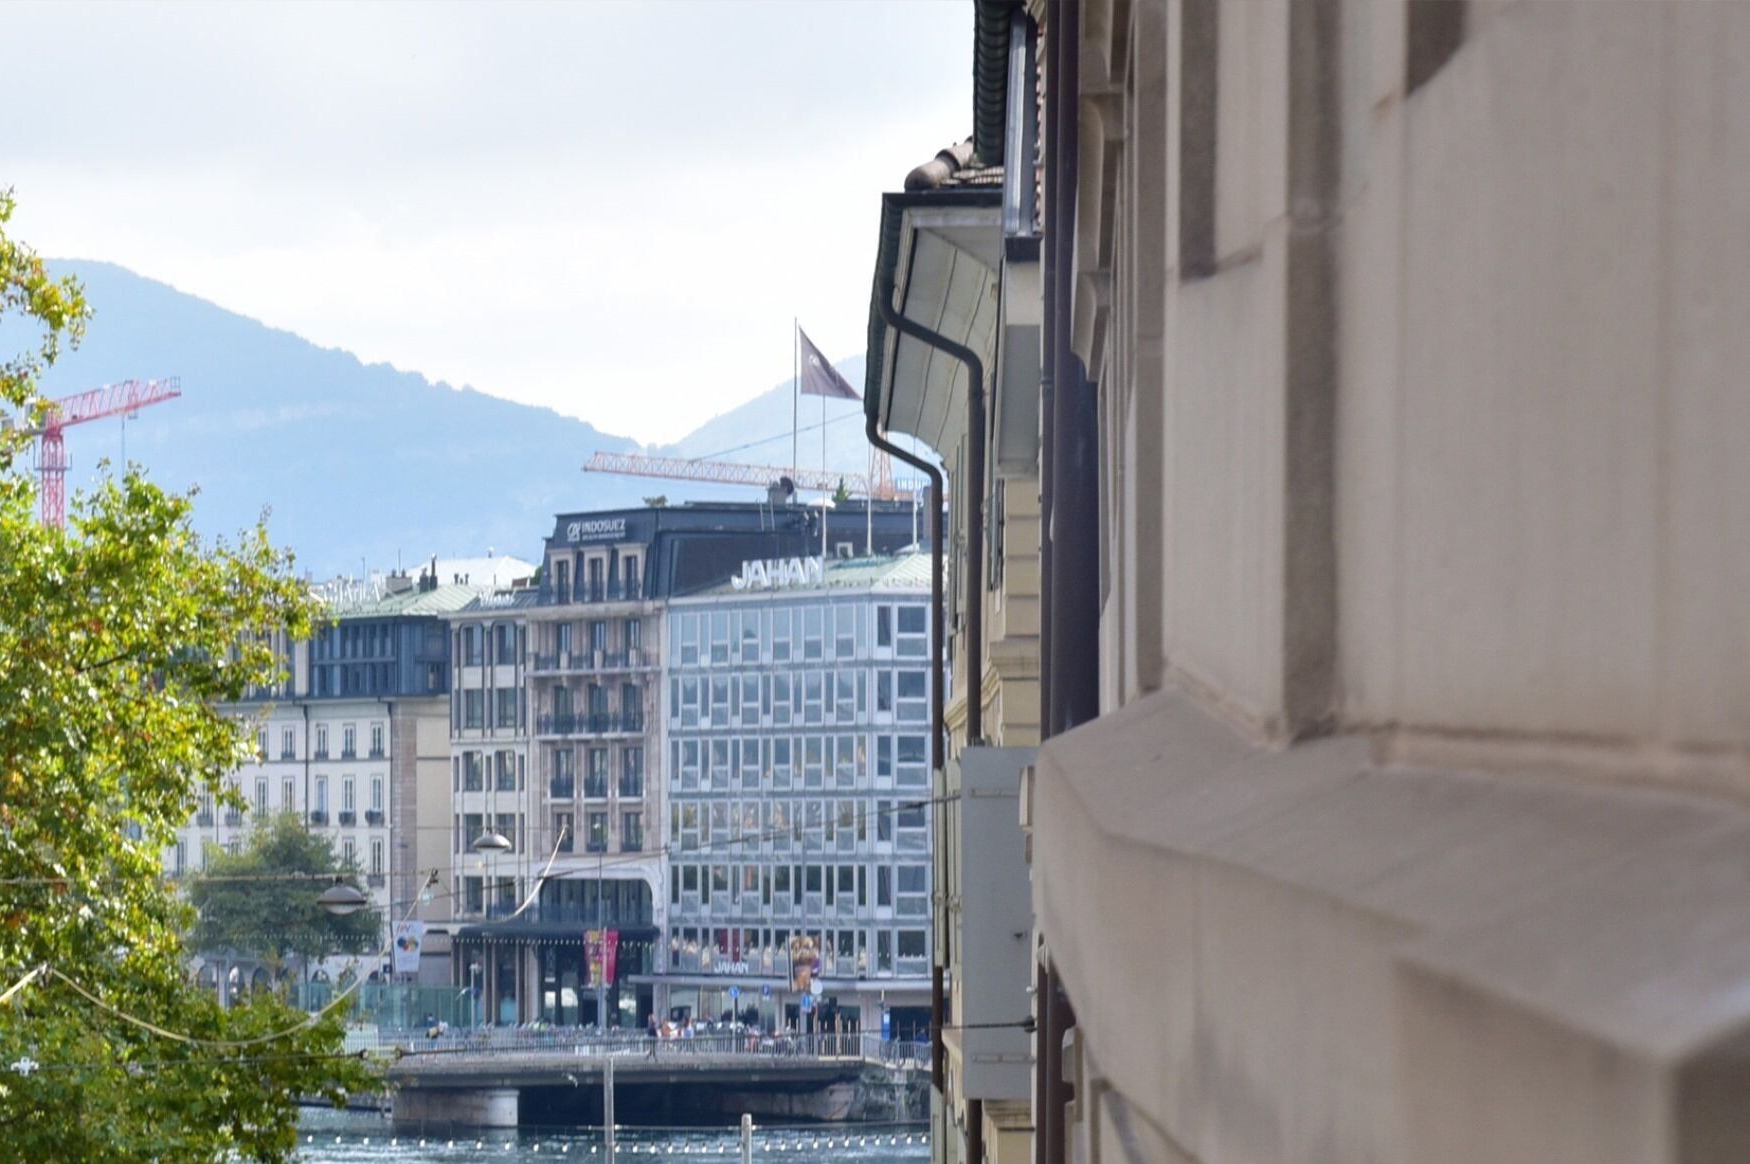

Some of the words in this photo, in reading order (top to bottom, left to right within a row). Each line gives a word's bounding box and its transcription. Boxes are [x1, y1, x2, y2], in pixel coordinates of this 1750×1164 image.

[581, 518, 626, 533] INDOSUEZ
[731, 556, 823, 590] JAHAN
[714, 960, 749, 974] JAHAN
